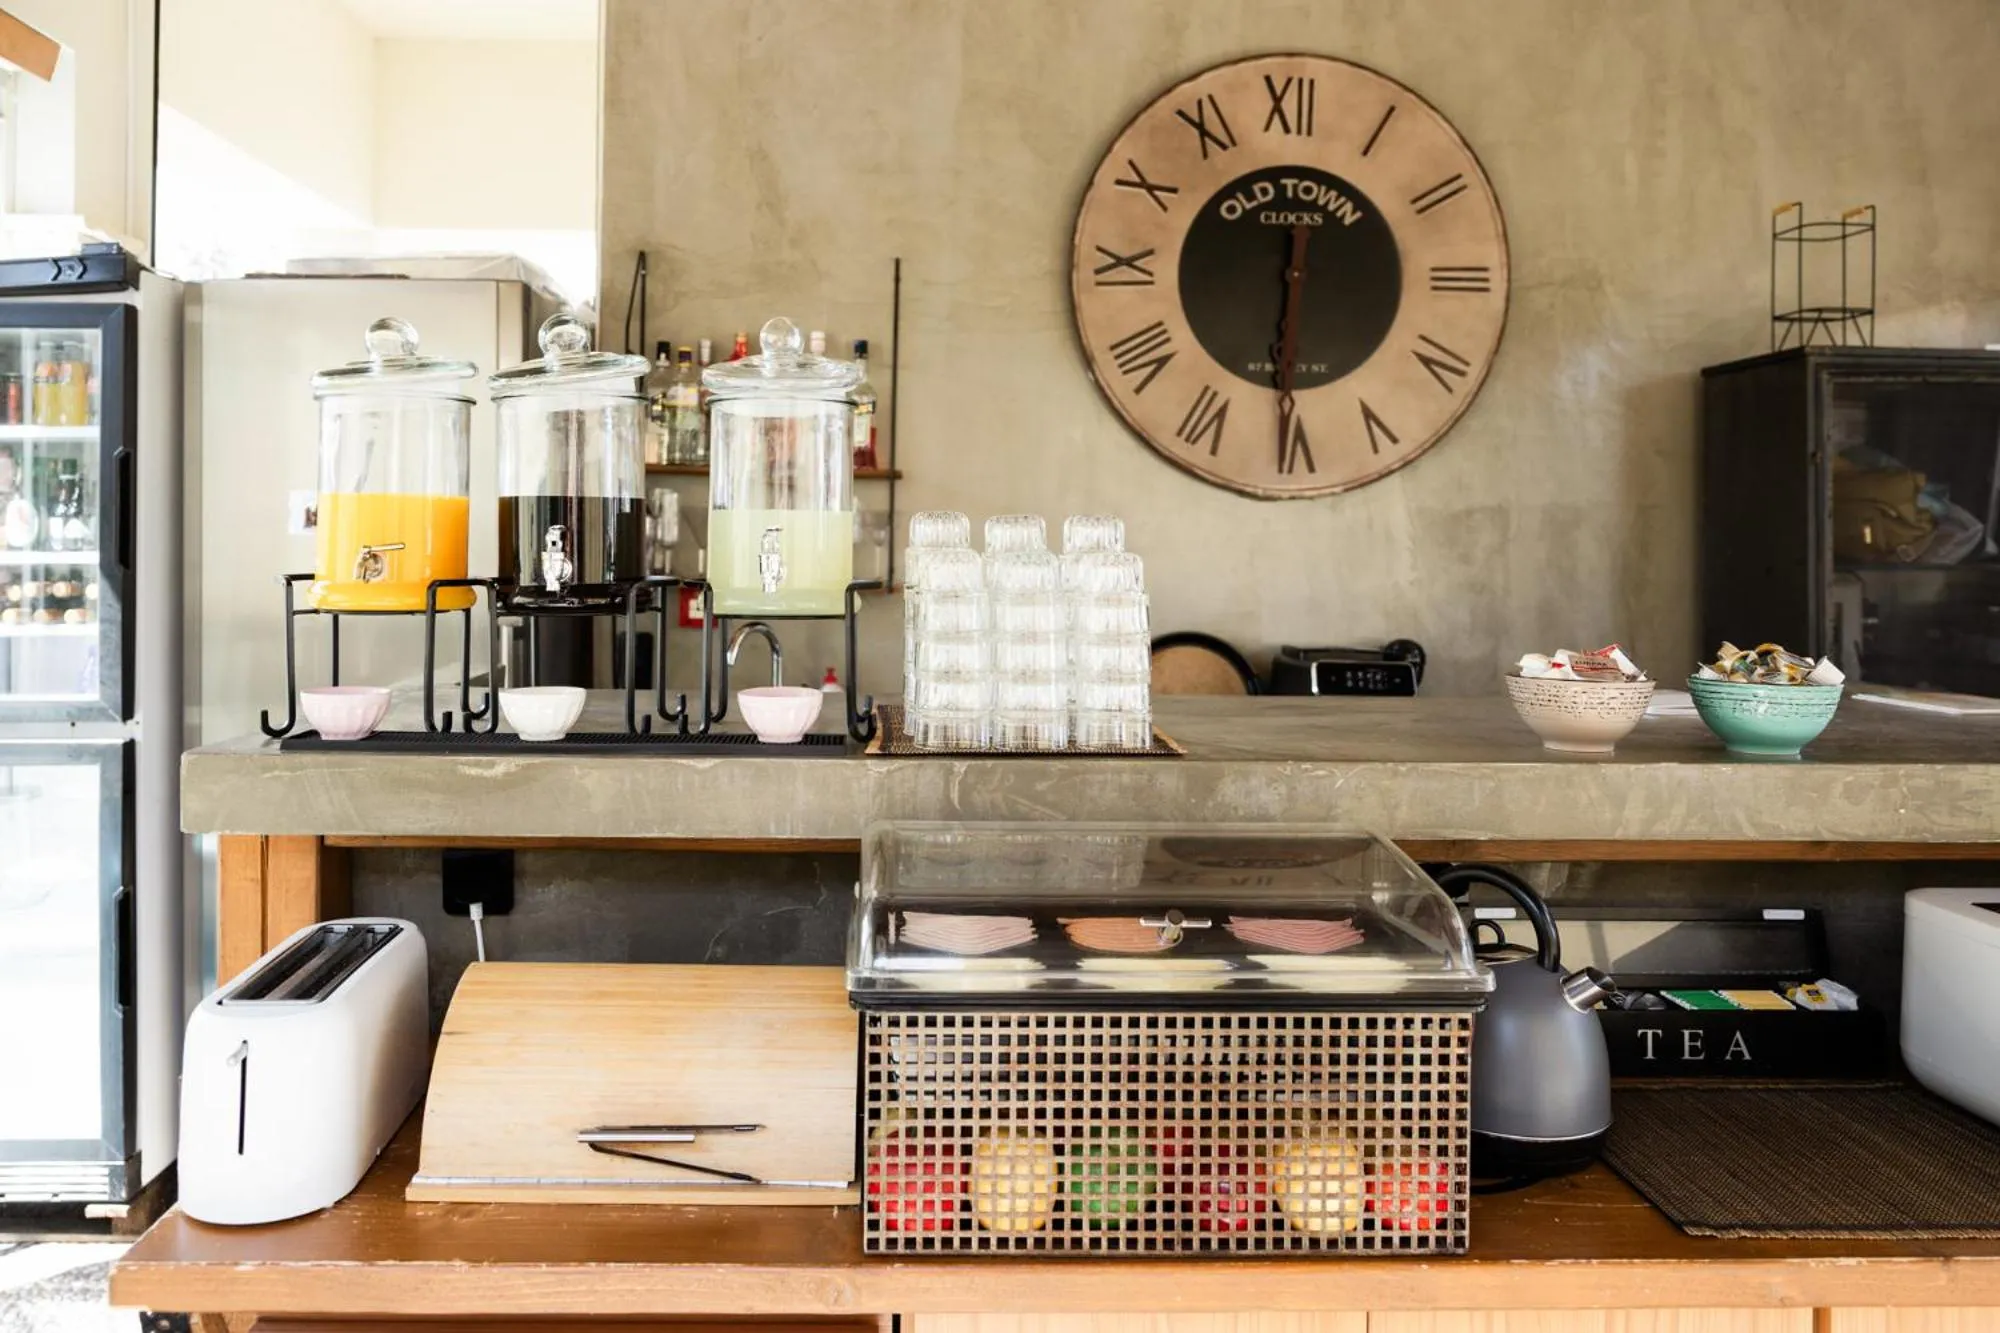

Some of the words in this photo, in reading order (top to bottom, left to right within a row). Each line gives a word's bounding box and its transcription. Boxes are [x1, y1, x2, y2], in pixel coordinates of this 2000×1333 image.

[1175, 93, 1237, 160] XI
[1263, 74, 1315, 136] XII
[1361, 104, 1396, 157] I
[1114, 158, 1179, 213] X
[1219, 181, 1276, 220] OLD
[1279, 178, 1363, 226] TOWN
[1409, 172, 1468, 215] II
[1259, 211, 1324, 226] CLOCKS
[1094, 244, 1155, 287] IX
[1430, 266, 1491, 293] III
[1108, 320, 1178, 395] VIII
[1411, 333, 1471, 394] IV
[1175, 384, 1230, 457] VII
[1276, 414, 1316, 475] V
[1358, 396, 1401, 455] V
[1637, 1028, 1752, 1061] TEA
